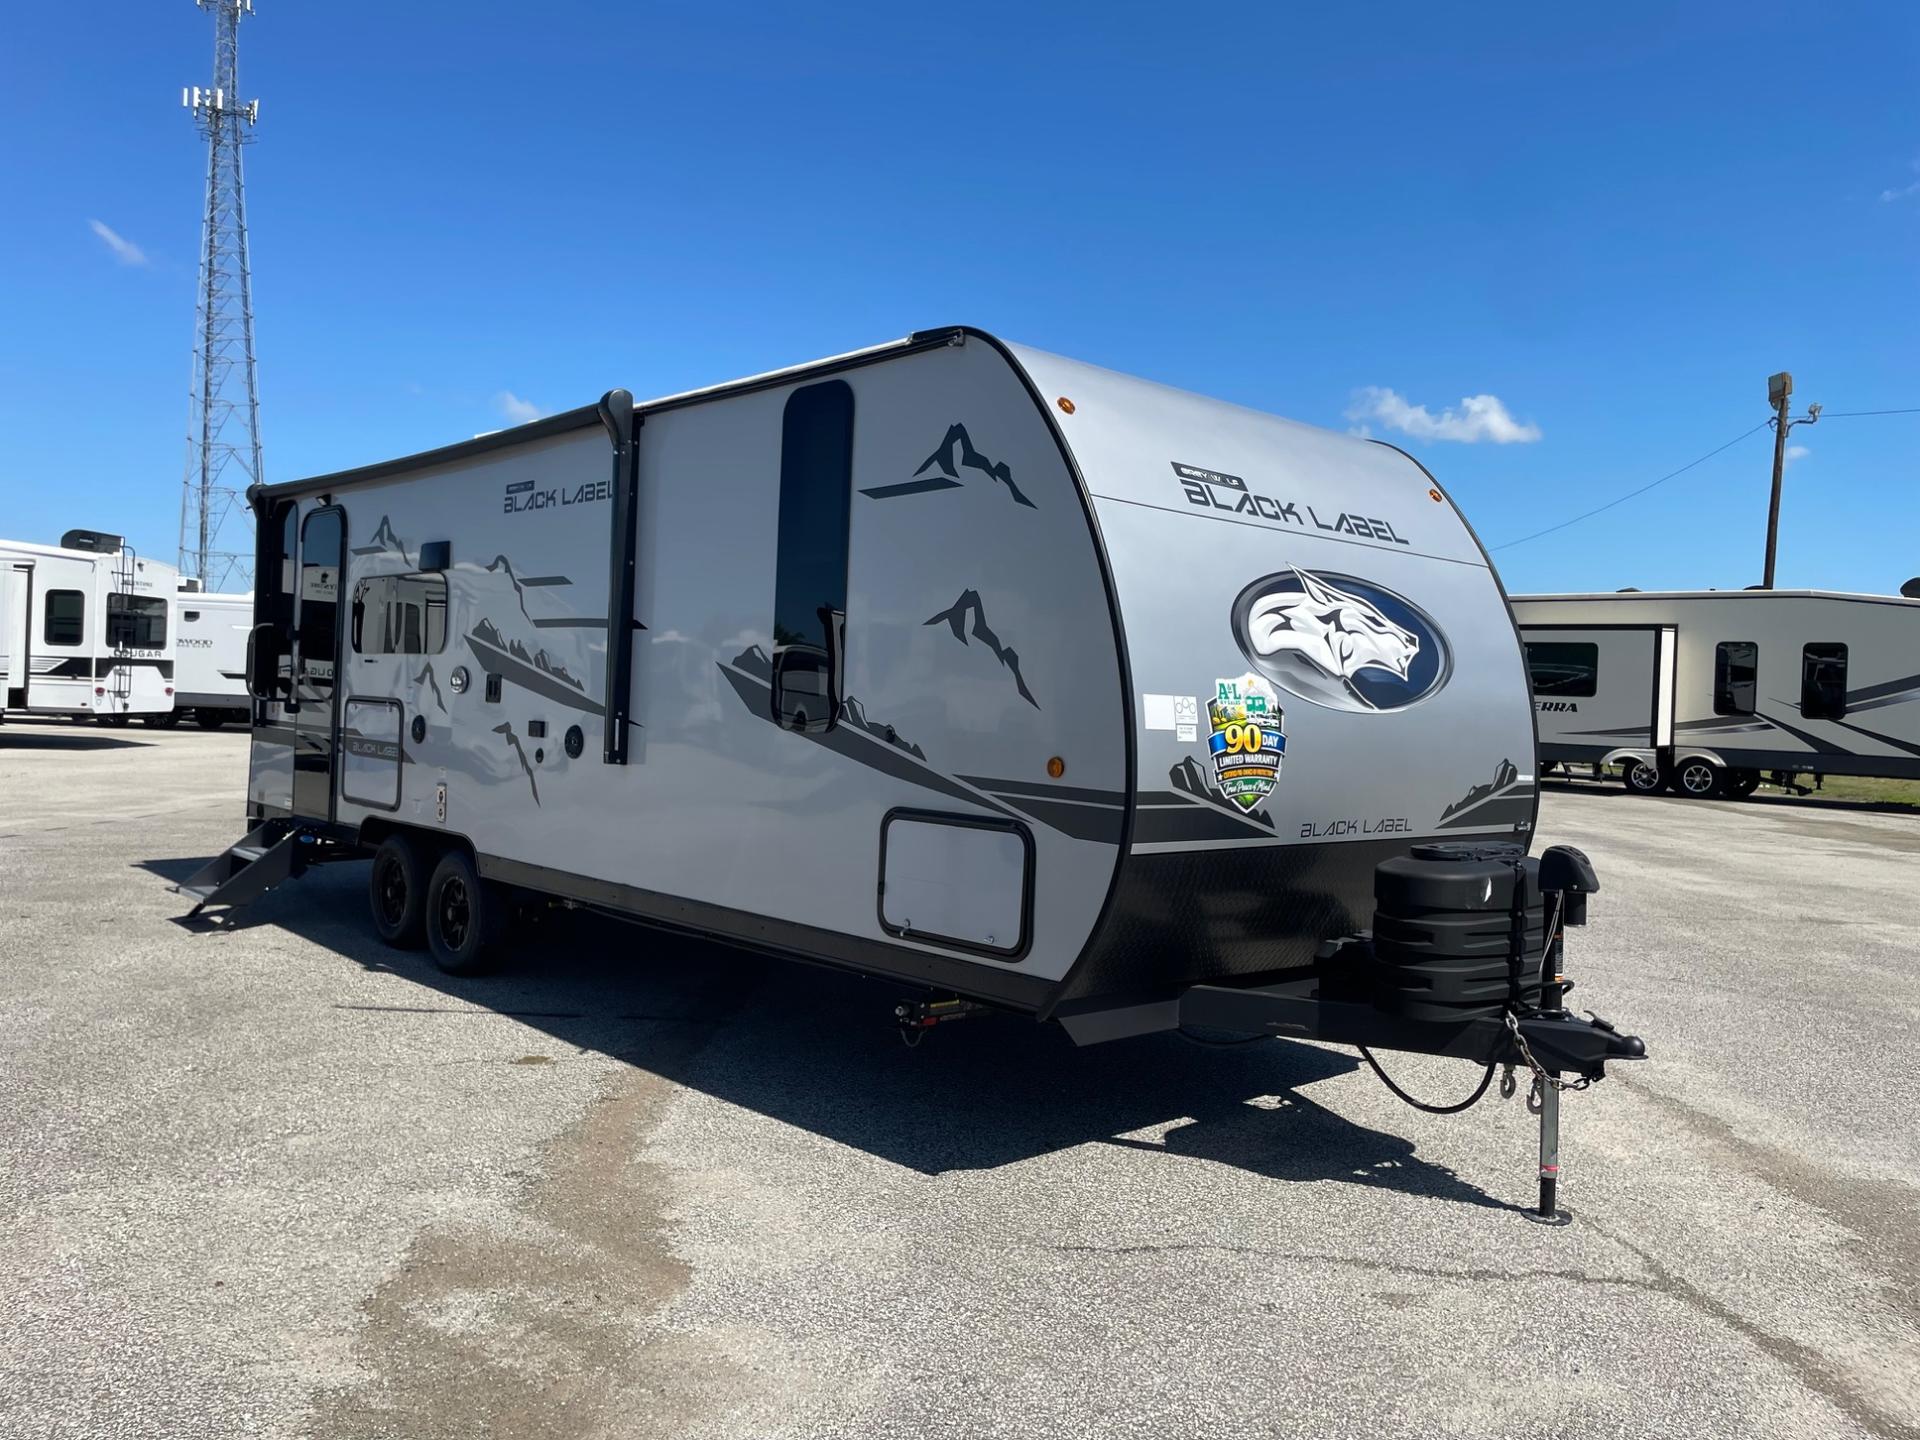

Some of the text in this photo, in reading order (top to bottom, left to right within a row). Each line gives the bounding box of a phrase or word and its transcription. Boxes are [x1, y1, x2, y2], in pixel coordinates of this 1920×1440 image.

[504, 489, 557, 514] BLACK
[562, 480, 612, 505] LABEL
[1180, 479, 1410, 545] BLACK LABEL
[1225, 724, 1280, 753] 90 DAY
[1219, 753, 1278, 767] LIMITED WARRANTY
[1300, 818, 1413, 838] BLACK LABEL
